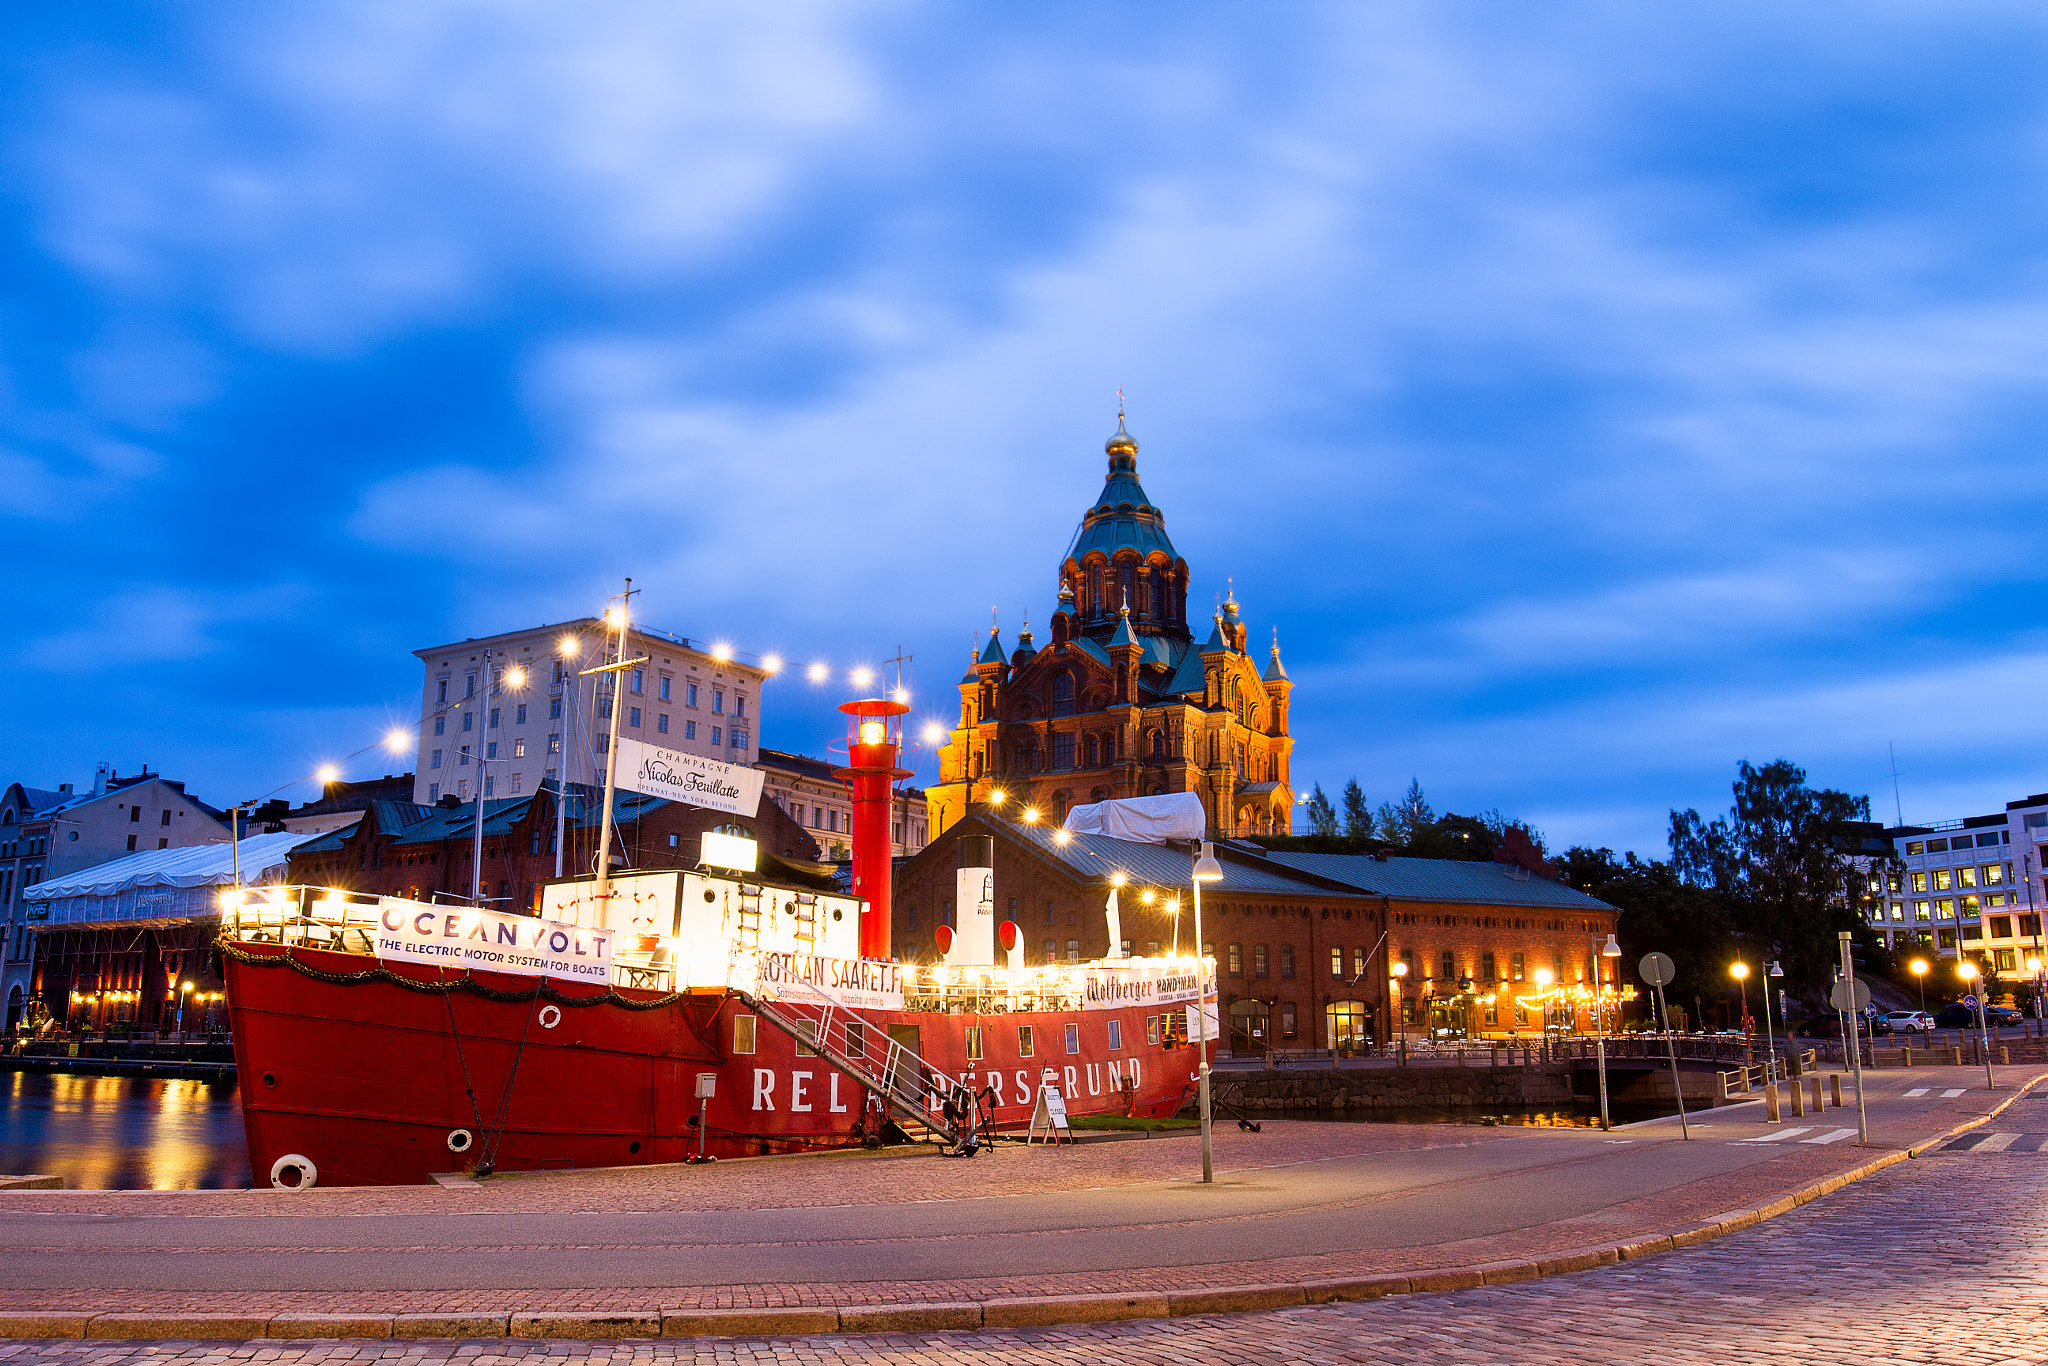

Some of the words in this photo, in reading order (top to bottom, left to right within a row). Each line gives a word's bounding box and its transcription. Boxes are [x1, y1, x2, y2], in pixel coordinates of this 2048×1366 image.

[637, 758, 683, 787] Nicolas
[683, 772, 739, 798] Feuillatte
[656, 751, 730, 774] CHAMPAGNE
[379, 938, 401, 951] THE
[405, 943, 461, 957] ELECTRIC
[464, 949, 504, 963] MOTOR
[508, 955, 548, 969] SYSTEM
[550, 961, 569, 972] FOR
[572, 964, 605, 976] BOATS
[1087, 975, 1152, 1005] Wolfberger
[1156, 974, 1198, 994] HANDYMAN
[1567, 1001, 1623, 1014] HOLIDAY
[752, 1058, 1141, 1113] RELADERSRUND
